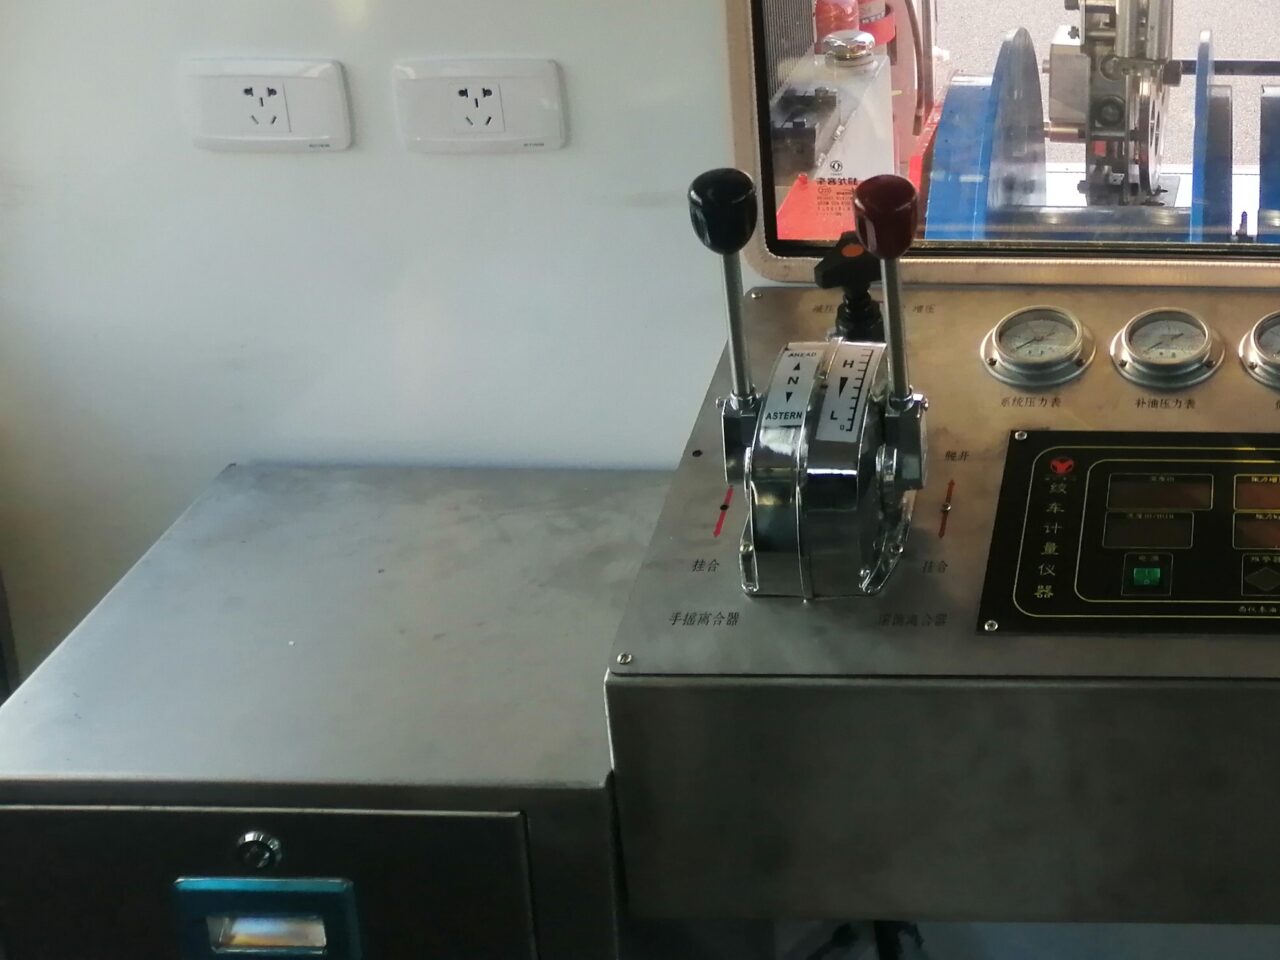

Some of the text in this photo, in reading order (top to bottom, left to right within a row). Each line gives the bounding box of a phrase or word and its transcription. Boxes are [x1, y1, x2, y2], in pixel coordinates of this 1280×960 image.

[842, 360, 855, 368] H
[787, 376, 800, 384] N
[765, 411, 802, 420] ASTERN
